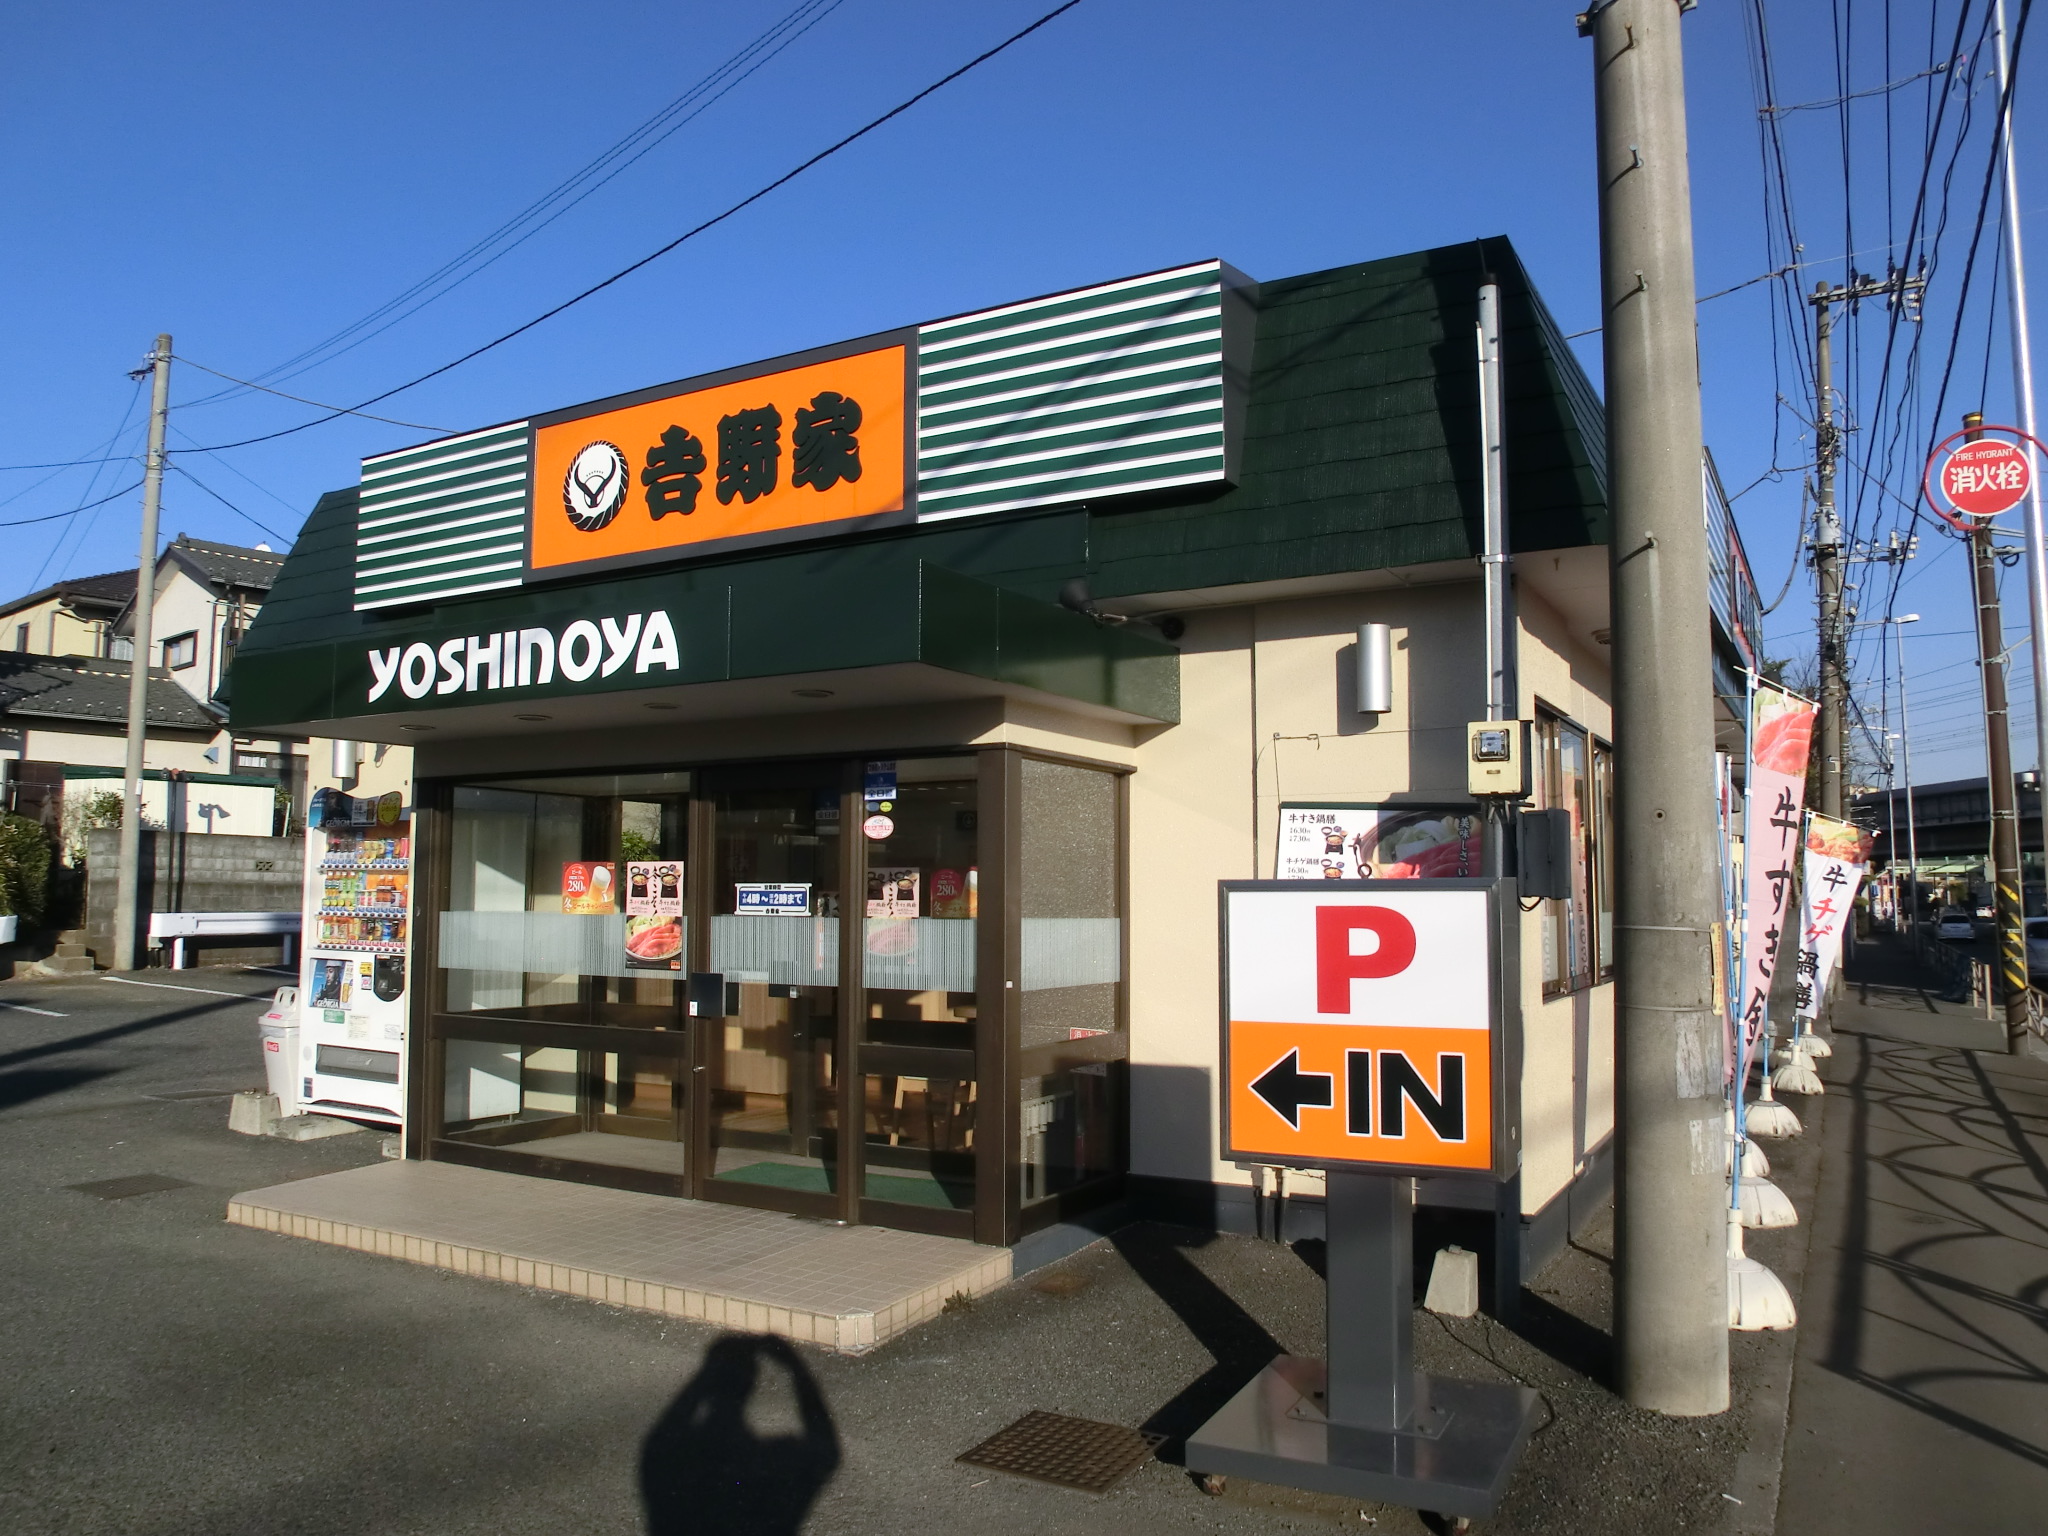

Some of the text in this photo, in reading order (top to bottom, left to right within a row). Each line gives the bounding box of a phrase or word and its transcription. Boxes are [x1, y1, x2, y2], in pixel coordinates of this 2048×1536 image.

[1949, 460, 2024, 495] 消火栓
[1955, 448, 2014, 462] FIRE HYDRANT
[368, 610, 680, 704] YOSHINOYA
[1288, 813, 1336, 824] 牛すき鍋膳
[1316, 905, 1417, 1014] P
[1345, 1048, 1467, 1143] IN
